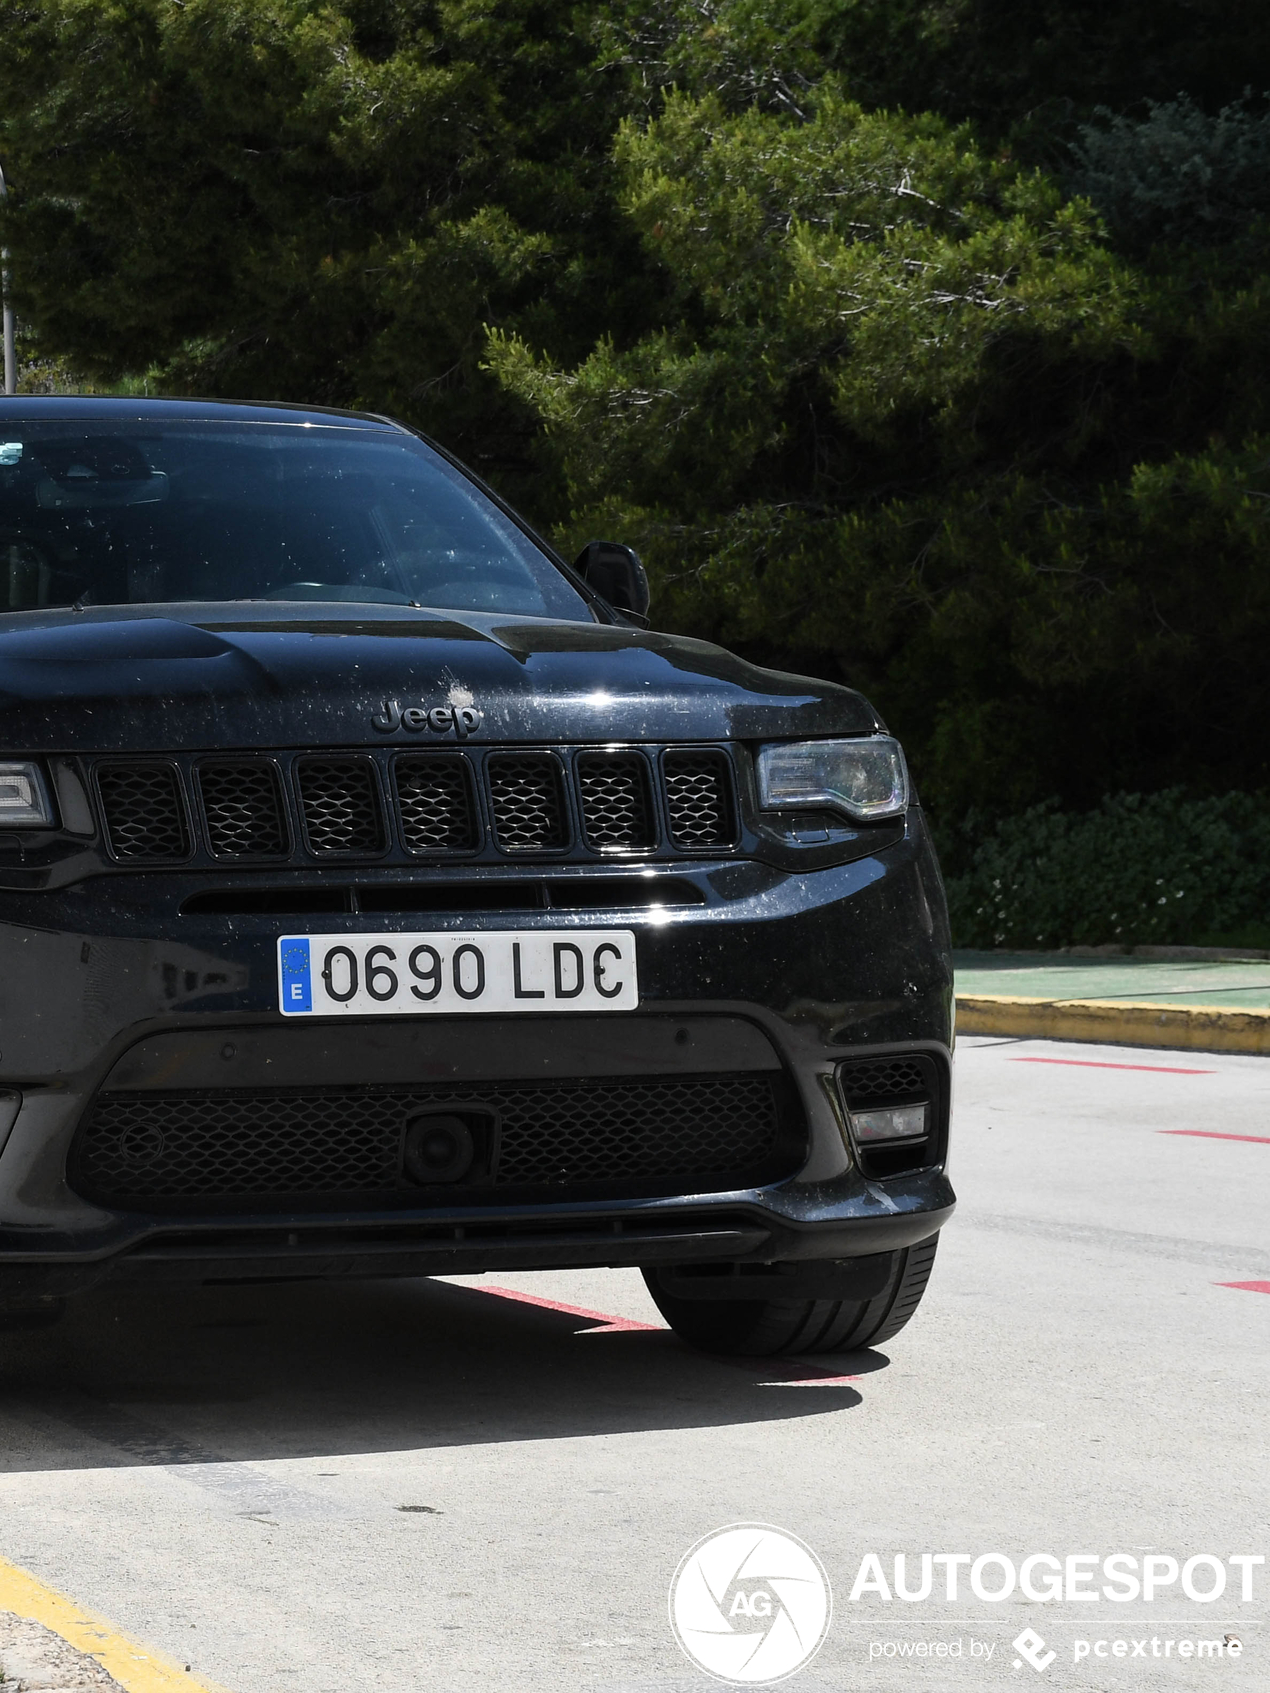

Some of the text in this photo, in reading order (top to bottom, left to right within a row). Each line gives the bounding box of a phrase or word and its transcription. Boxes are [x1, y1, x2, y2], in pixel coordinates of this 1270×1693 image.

[371, 700, 480, 738] Jeep
[324, 942, 623, 1002] 0690 LDC
[291, 983, 303, 1000] E
